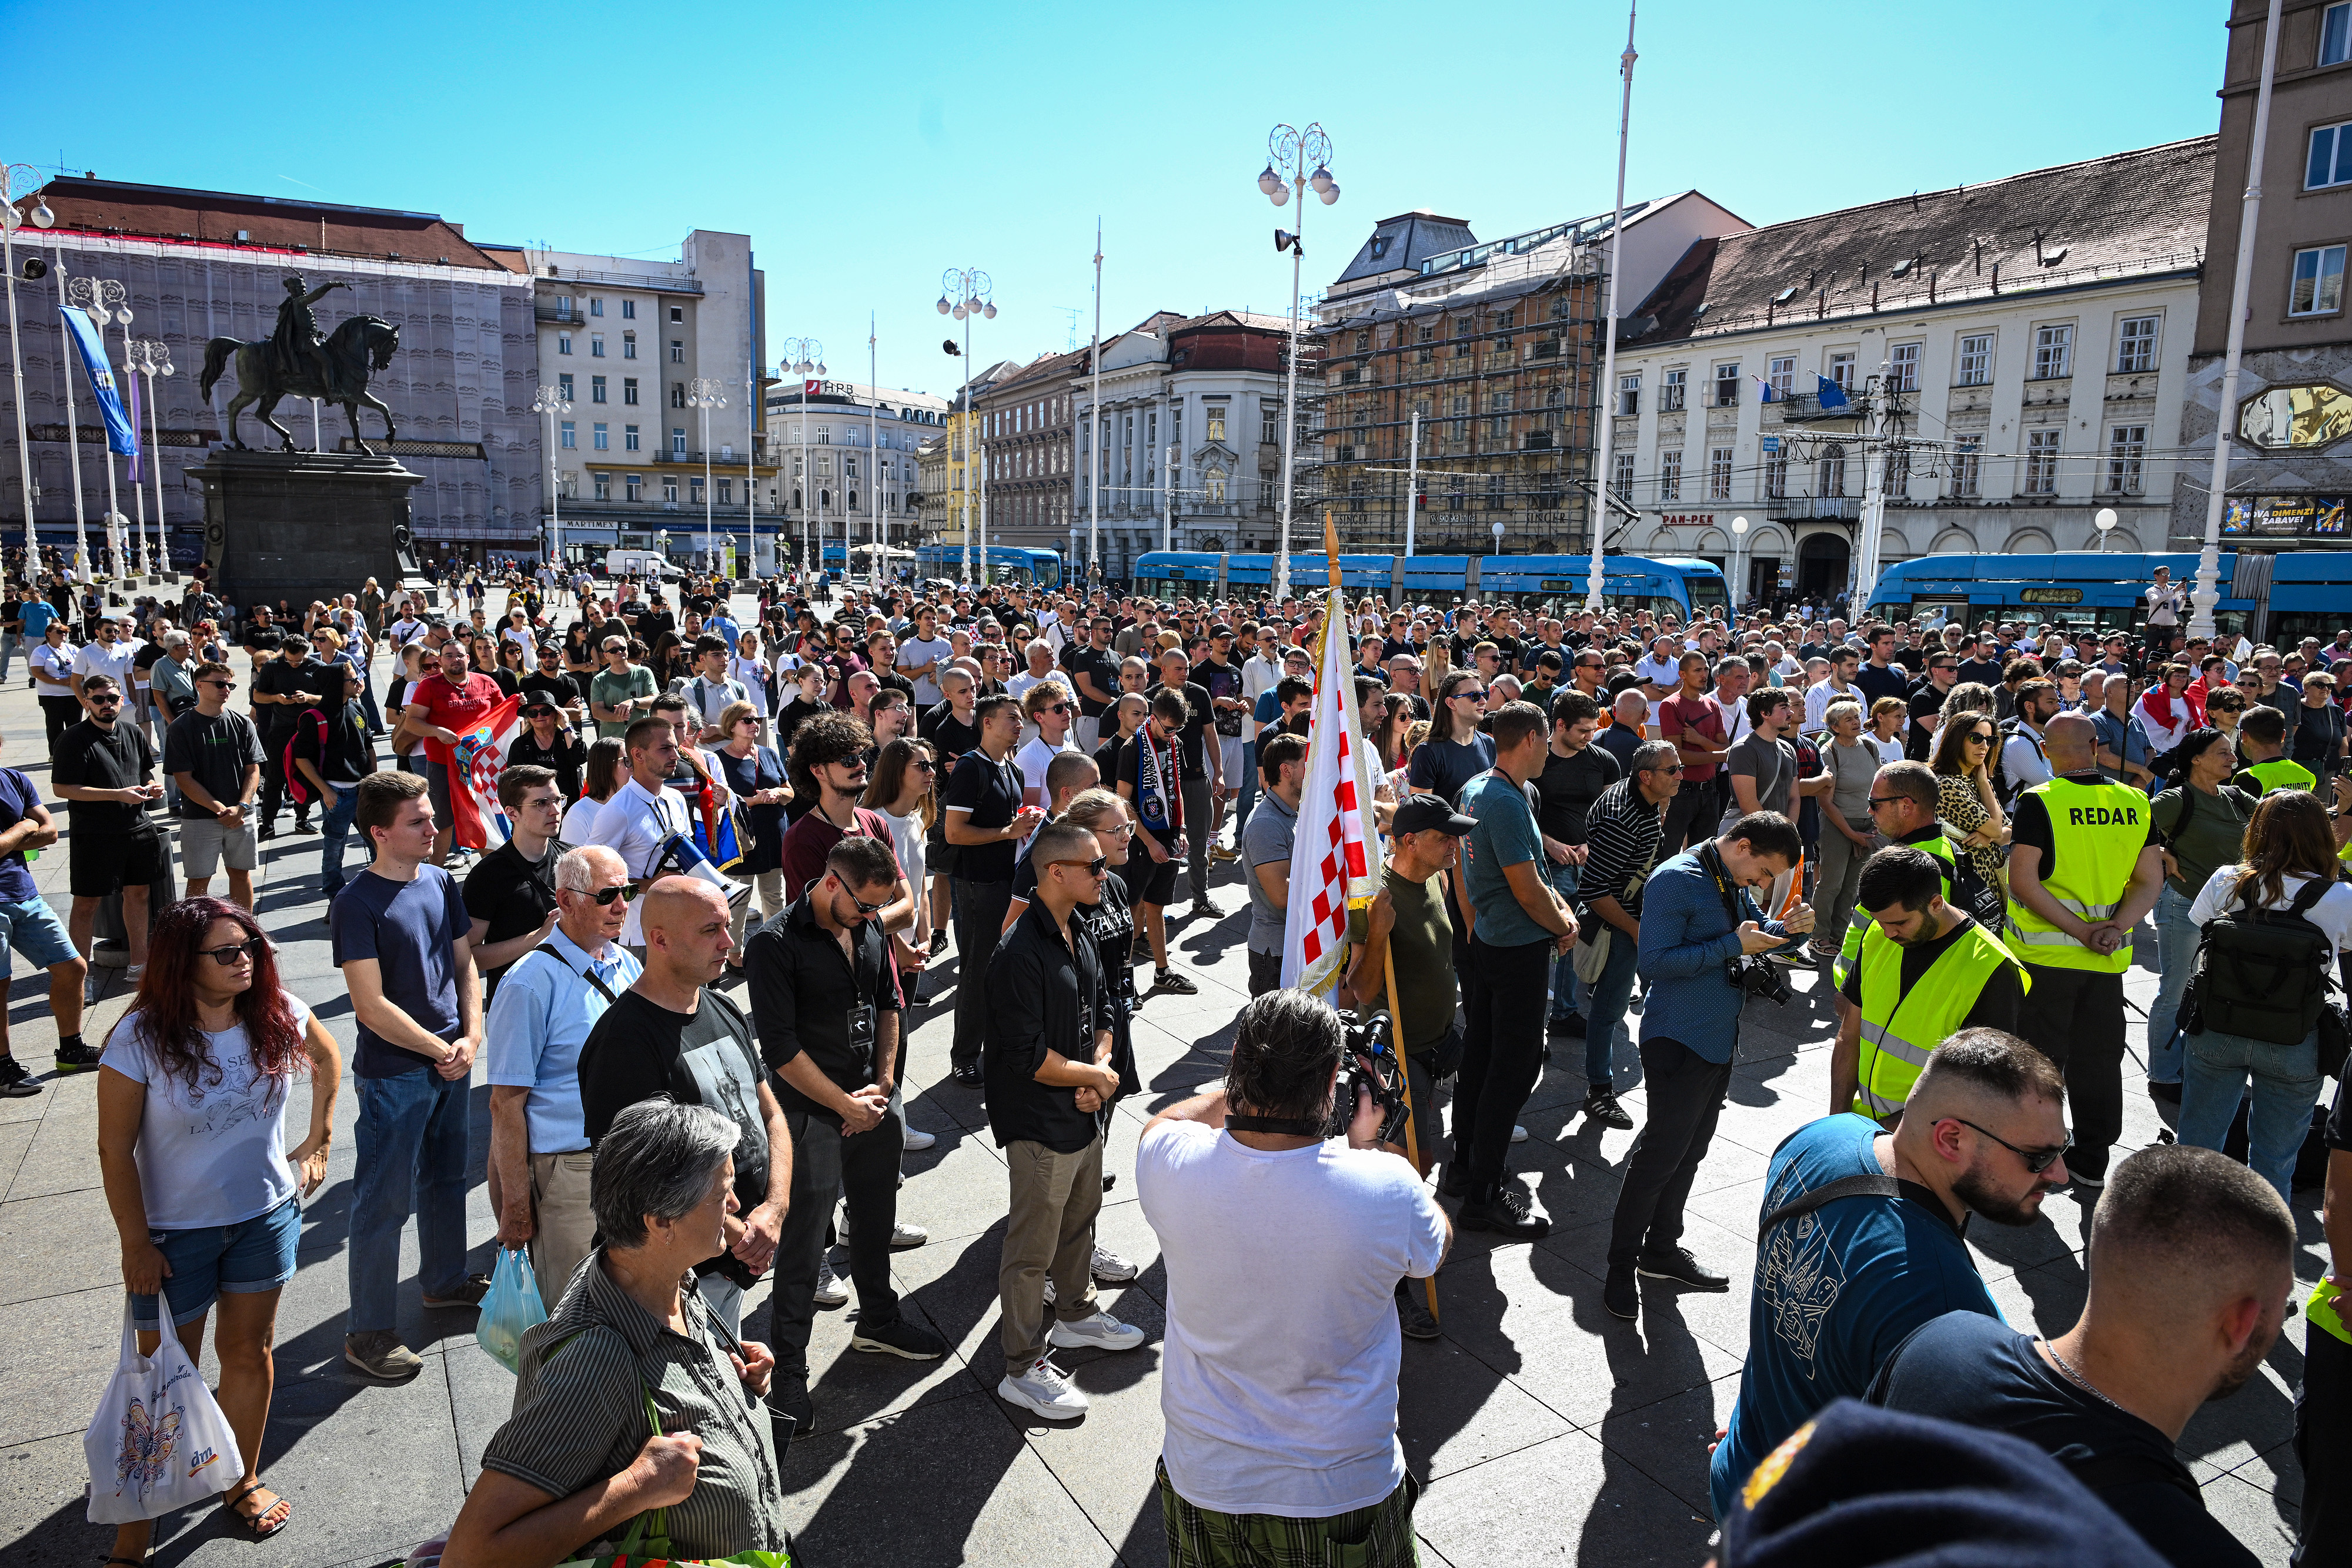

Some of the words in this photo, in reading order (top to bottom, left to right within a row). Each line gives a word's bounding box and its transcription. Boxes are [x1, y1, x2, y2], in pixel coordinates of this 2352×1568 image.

[1663, 514, 1714, 523] PAN-PEK
[2272, 507, 2325, 517] DIMENZIA
[2262, 516, 2304, 525] ZABAVE!
[448, 698, 485, 708] BROOKLYN
[1143, 755, 1159, 790] SNAGE
[2281, 781, 2310, 790] SECURITY
[2069, 807, 2139, 825] REDAR
[1466, 835, 1474, 859] STEP
[1716, 875, 1725, 892] Nikon
[228, 1054, 250, 1068] SE
[190, 1122, 213, 1135] LA
[252, 1105, 279, 1121] VIE
[191, 1446, 213, 1468] dm
